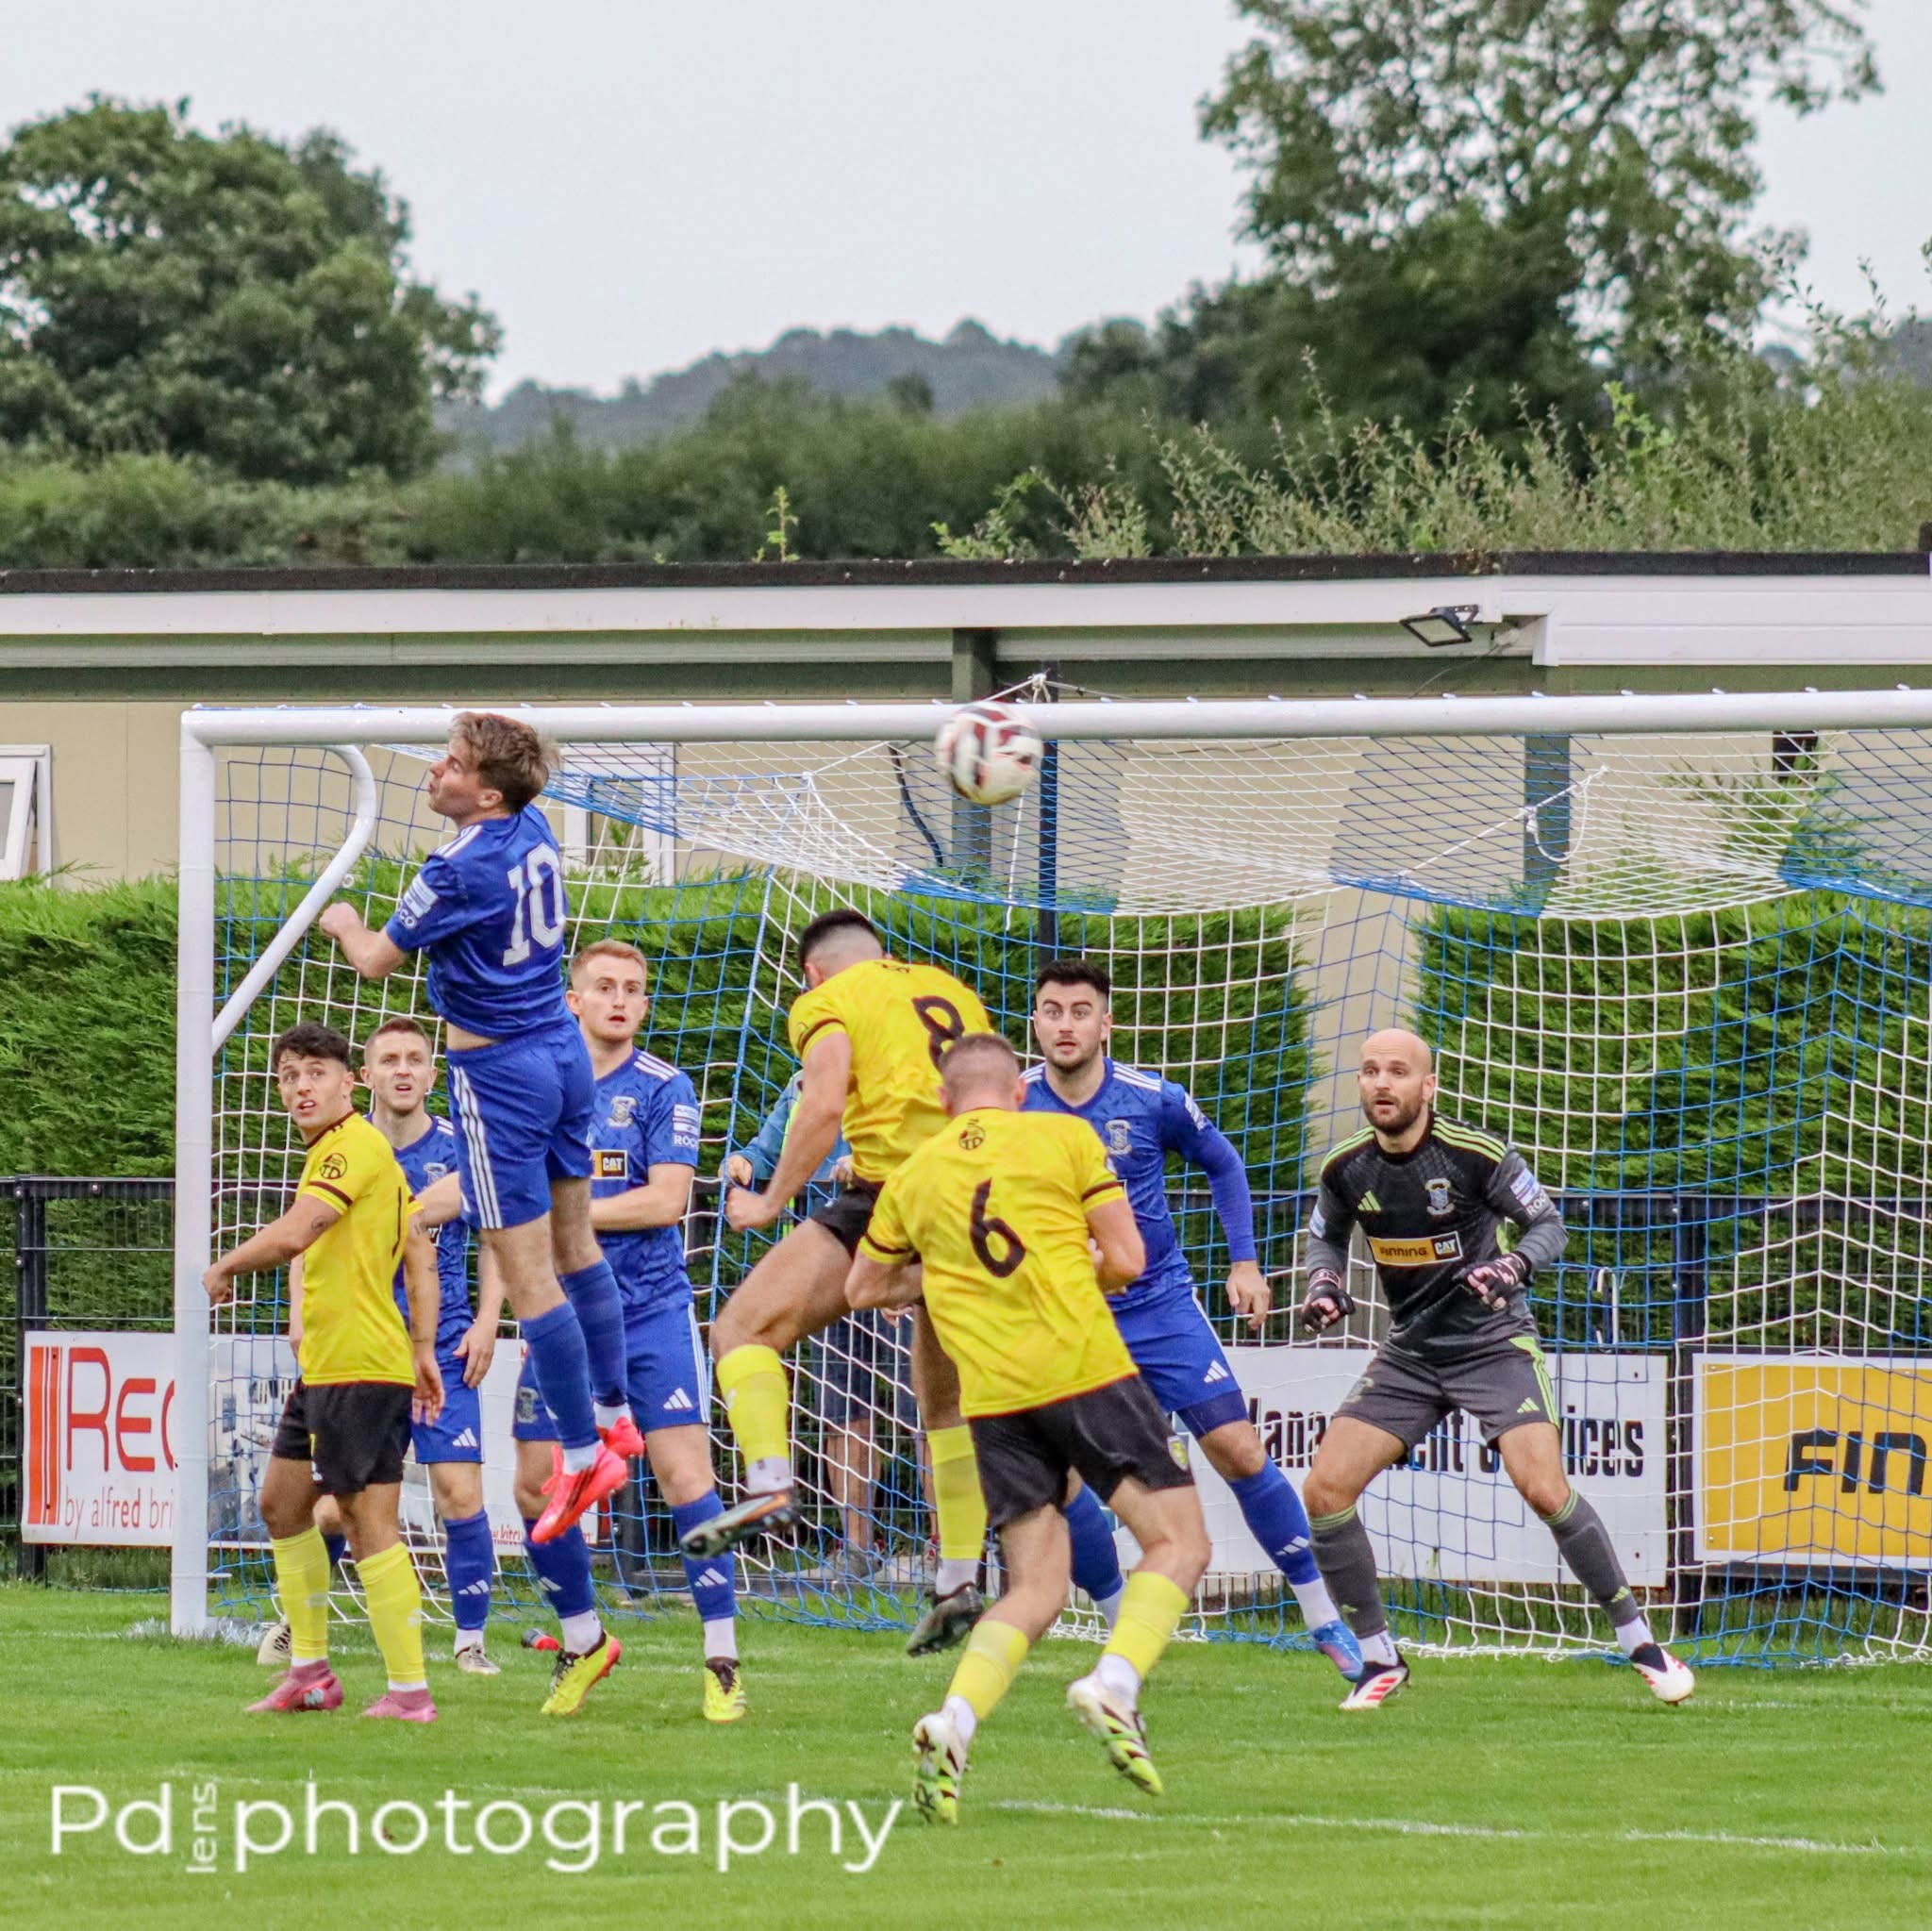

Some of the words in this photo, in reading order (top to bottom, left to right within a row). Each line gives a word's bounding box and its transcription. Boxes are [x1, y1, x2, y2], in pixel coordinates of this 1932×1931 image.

[503, 846, 565, 966] 10
[911, 996, 965, 1074] 8
[603, 1157, 623, 1171] CAT
[970, 1177, 1026, 1278] 6
[1435, 1240, 1456, 1256] CAT
[65, 1488, 84, 1540] by
[92, 1487, 142, 1528] alfred
